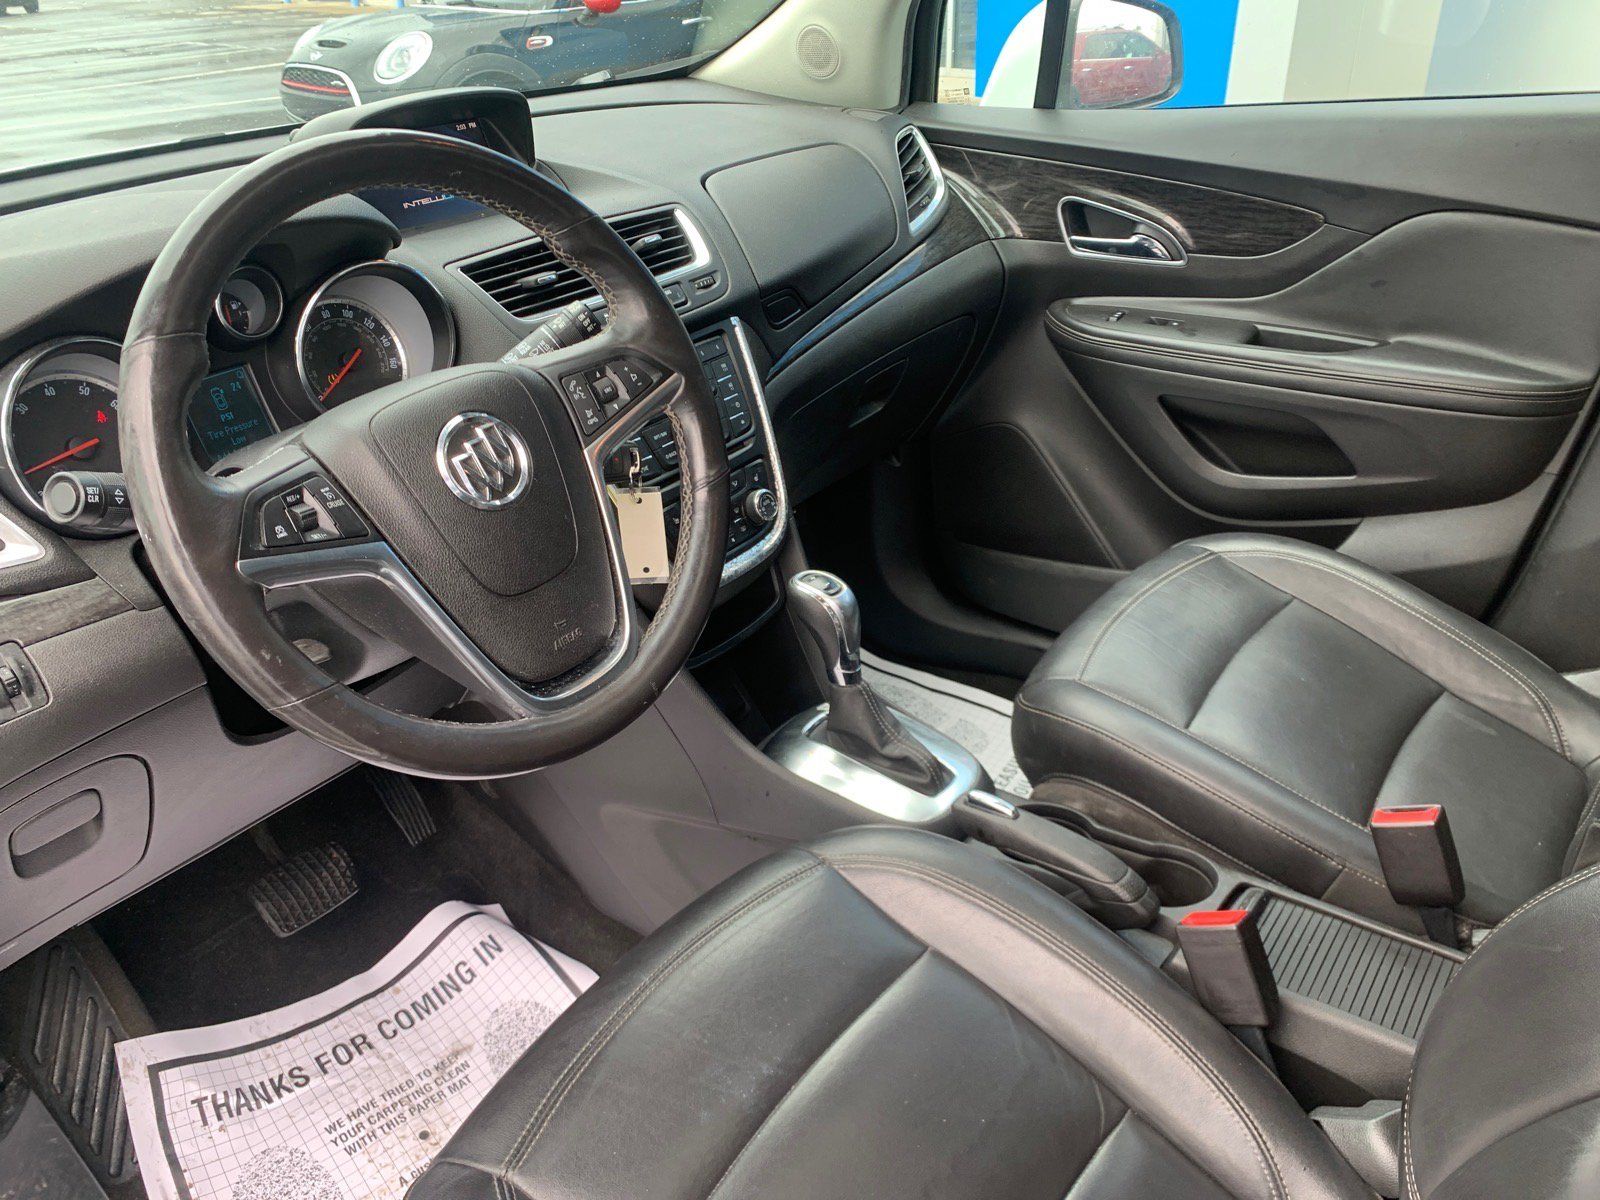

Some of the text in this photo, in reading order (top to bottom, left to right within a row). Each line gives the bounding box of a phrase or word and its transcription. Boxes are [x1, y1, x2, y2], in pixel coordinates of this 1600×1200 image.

[342, 309, 354, 318] 100
[364, 318, 375, 330] 120
[380, 334, 390, 347] 140
[390, 358, 398, 368] 160
[44, 386, 56, 396] 40
[79, 386, 90, 396] 50
[220, 412, 234, 422] PSI
[208, 419, 259, 440] Tire Pressure
[190, 934, 502, 1128] THANKS FOR COMING IN
[324, 1052, 460, 1135] WE HAVE TRIED TO KEEP
[330, 1060, 471, 1148] YOUR CARPETING CLEAN
[344, 1074, 473, 1158] WITH THIS PAPER MAT
[399, 1176, 409, 1188] A
